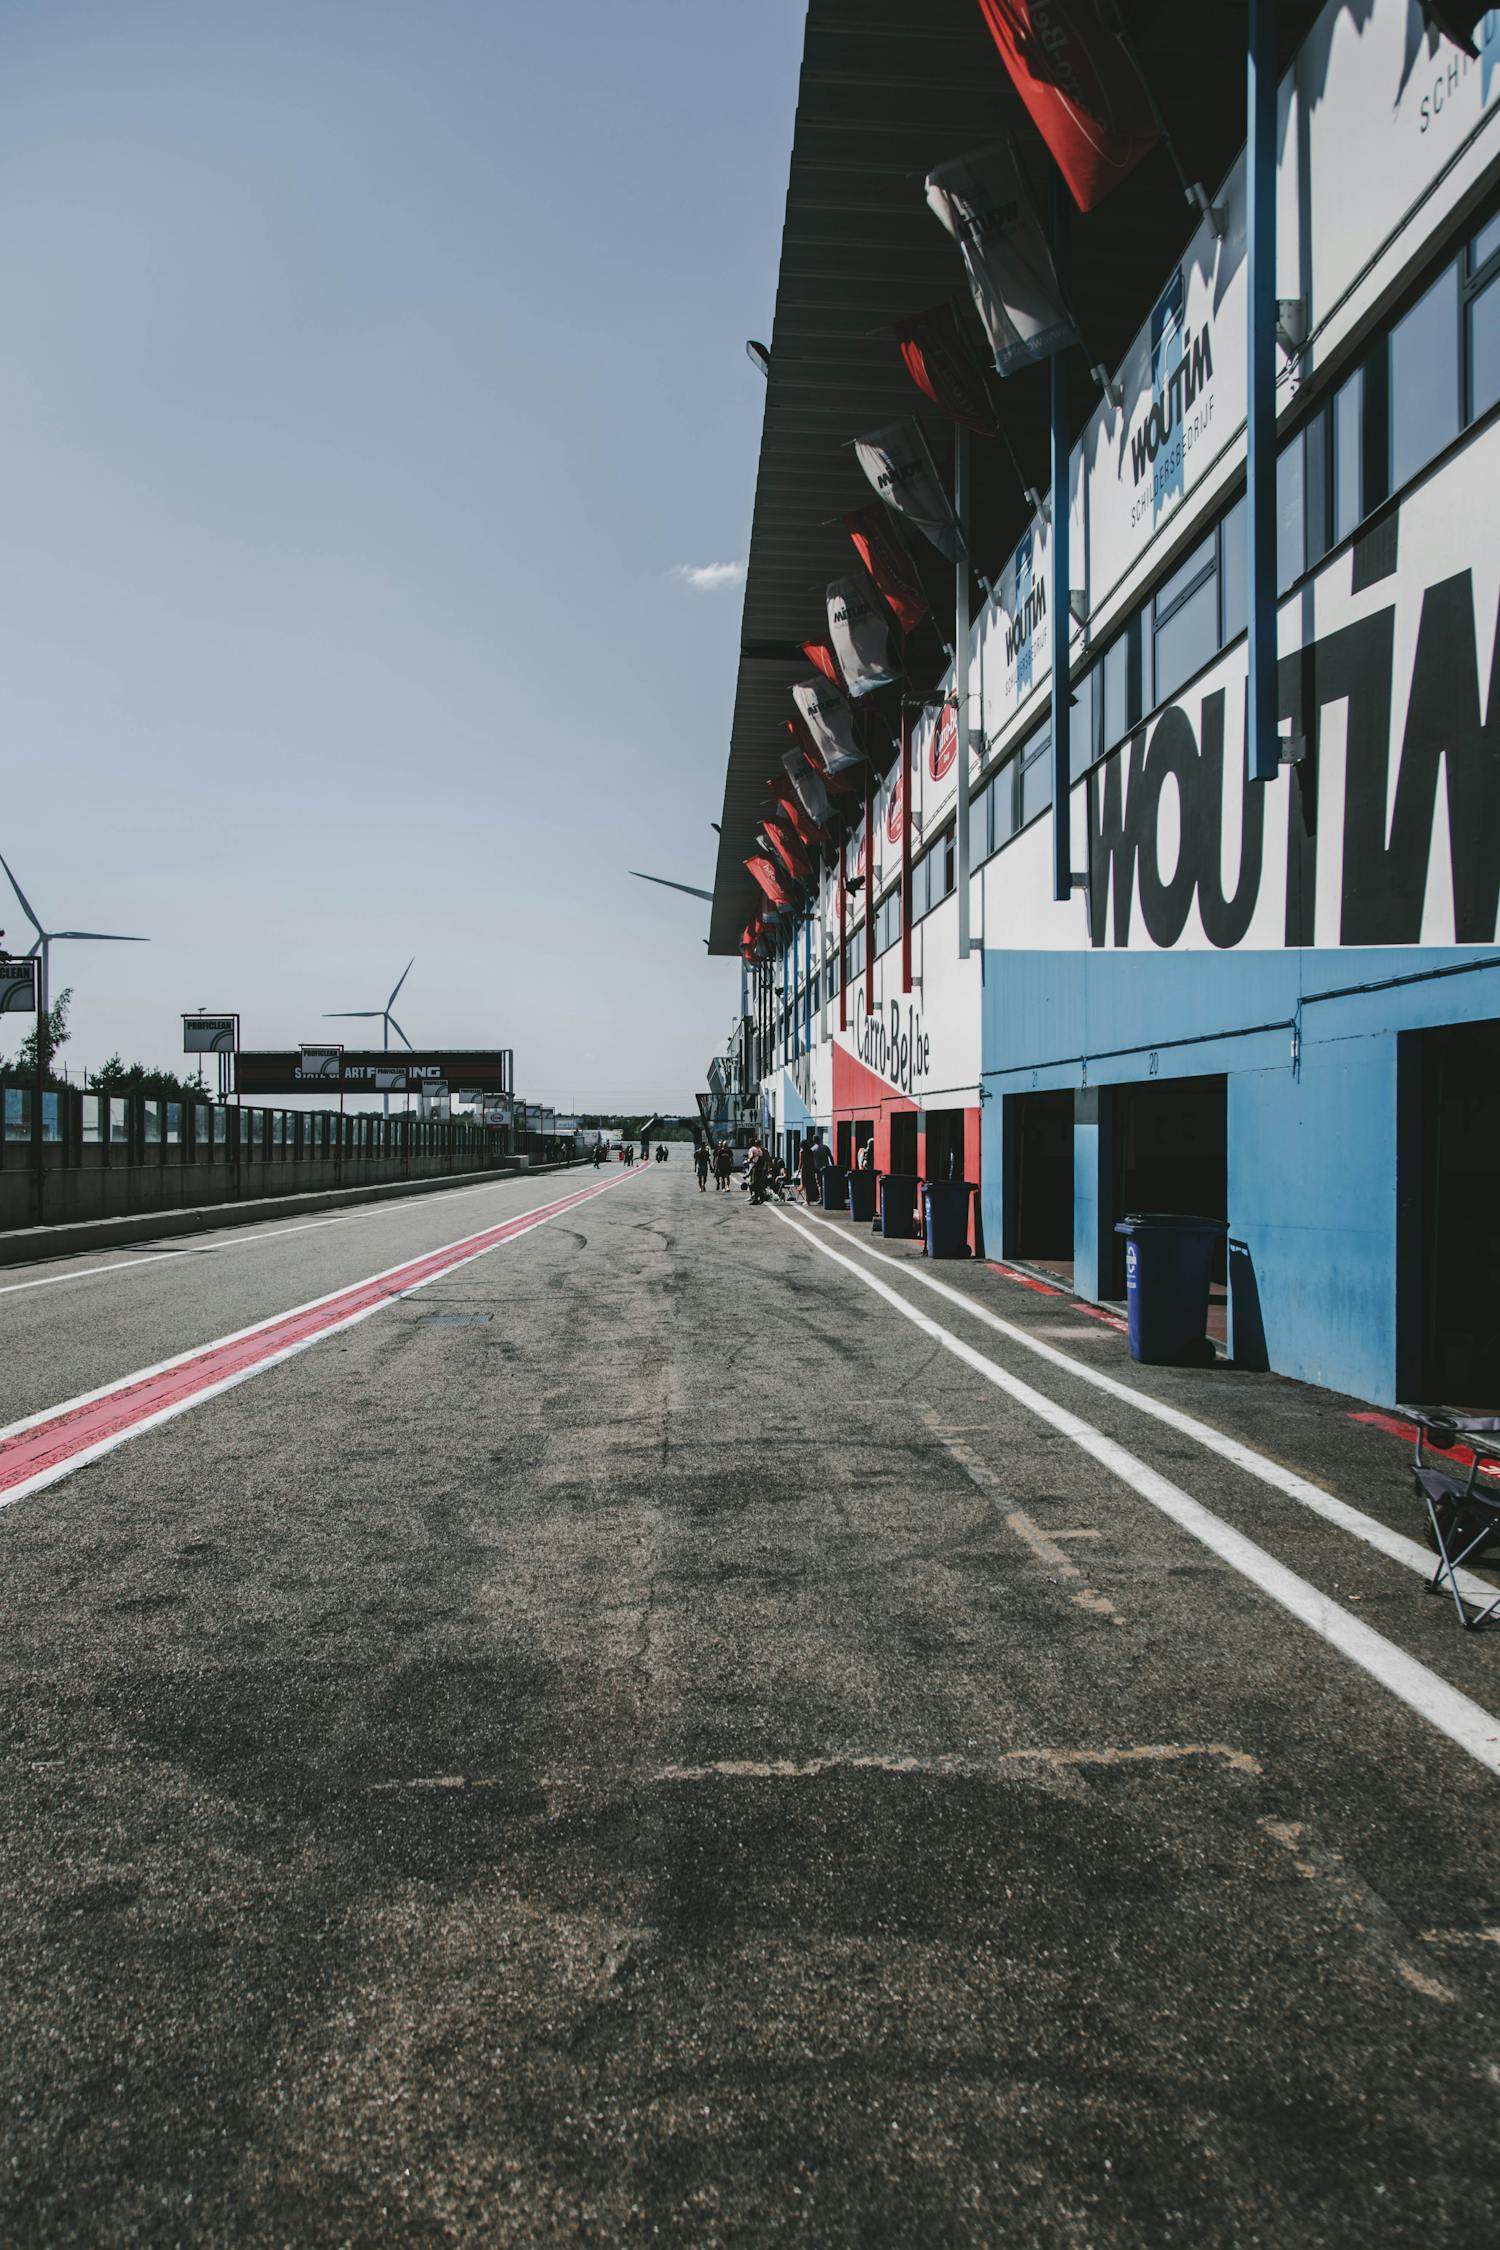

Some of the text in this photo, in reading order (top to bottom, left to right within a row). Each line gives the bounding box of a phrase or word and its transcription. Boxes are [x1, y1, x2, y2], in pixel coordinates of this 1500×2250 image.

[1131, 394, 1214, 528] SCHILDERSBEDRIJF
[187, 1021, 231, 1030] PROFICLEAN
[857, 987, 930, 1094] Carro-Bel.be
[344, 1067, 366, 1079] ART
[1148, 1051, 1159, 1076] 20
